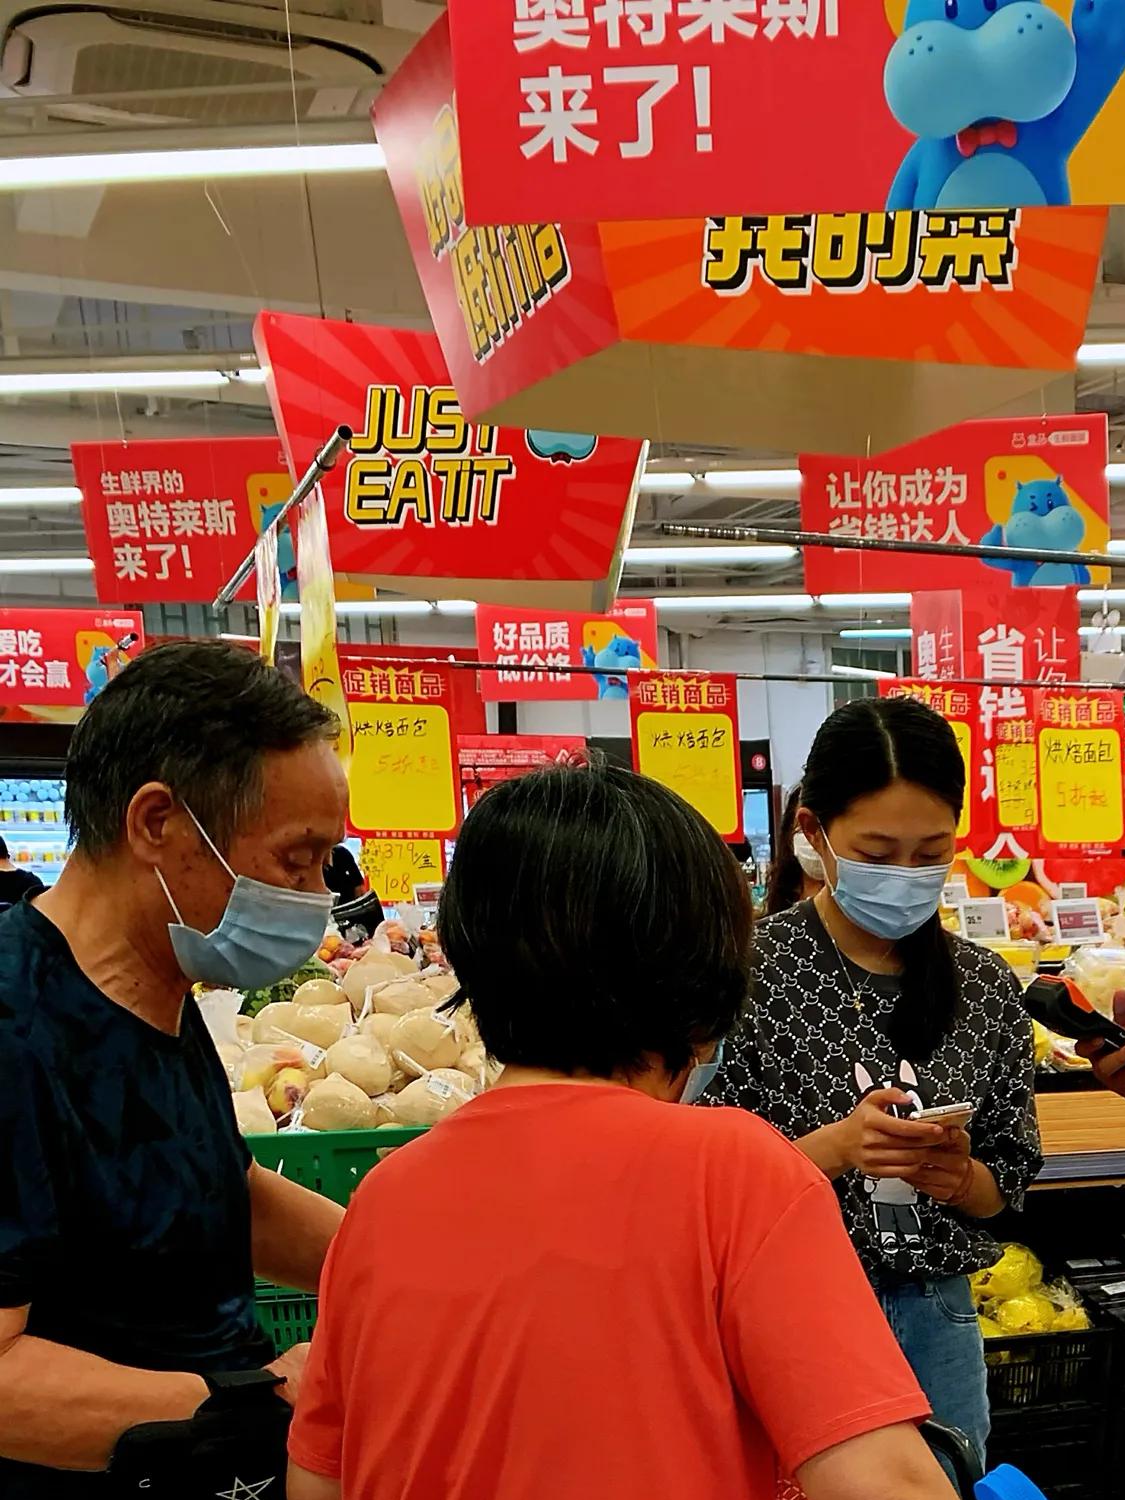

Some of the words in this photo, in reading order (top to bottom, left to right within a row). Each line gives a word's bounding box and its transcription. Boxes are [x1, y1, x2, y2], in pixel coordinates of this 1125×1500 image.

[518, 64, 714, 162] 来了!
[701, 208, 1022, 297] 我的菜
[100, 469, 184, 496] 生鲜界的
[826, 466, 968, 509] 让你成为
[106, 499, 237, 538] 奥特莱斯
[113, 543, 193, 582] 来了!
[493, 621, 570, 651] 好品质
[344, 669, 442, 696] 促销商品
[639, 681, 727, 706] 促销商品
[1042, 700, 1115, 723] 促销商品
